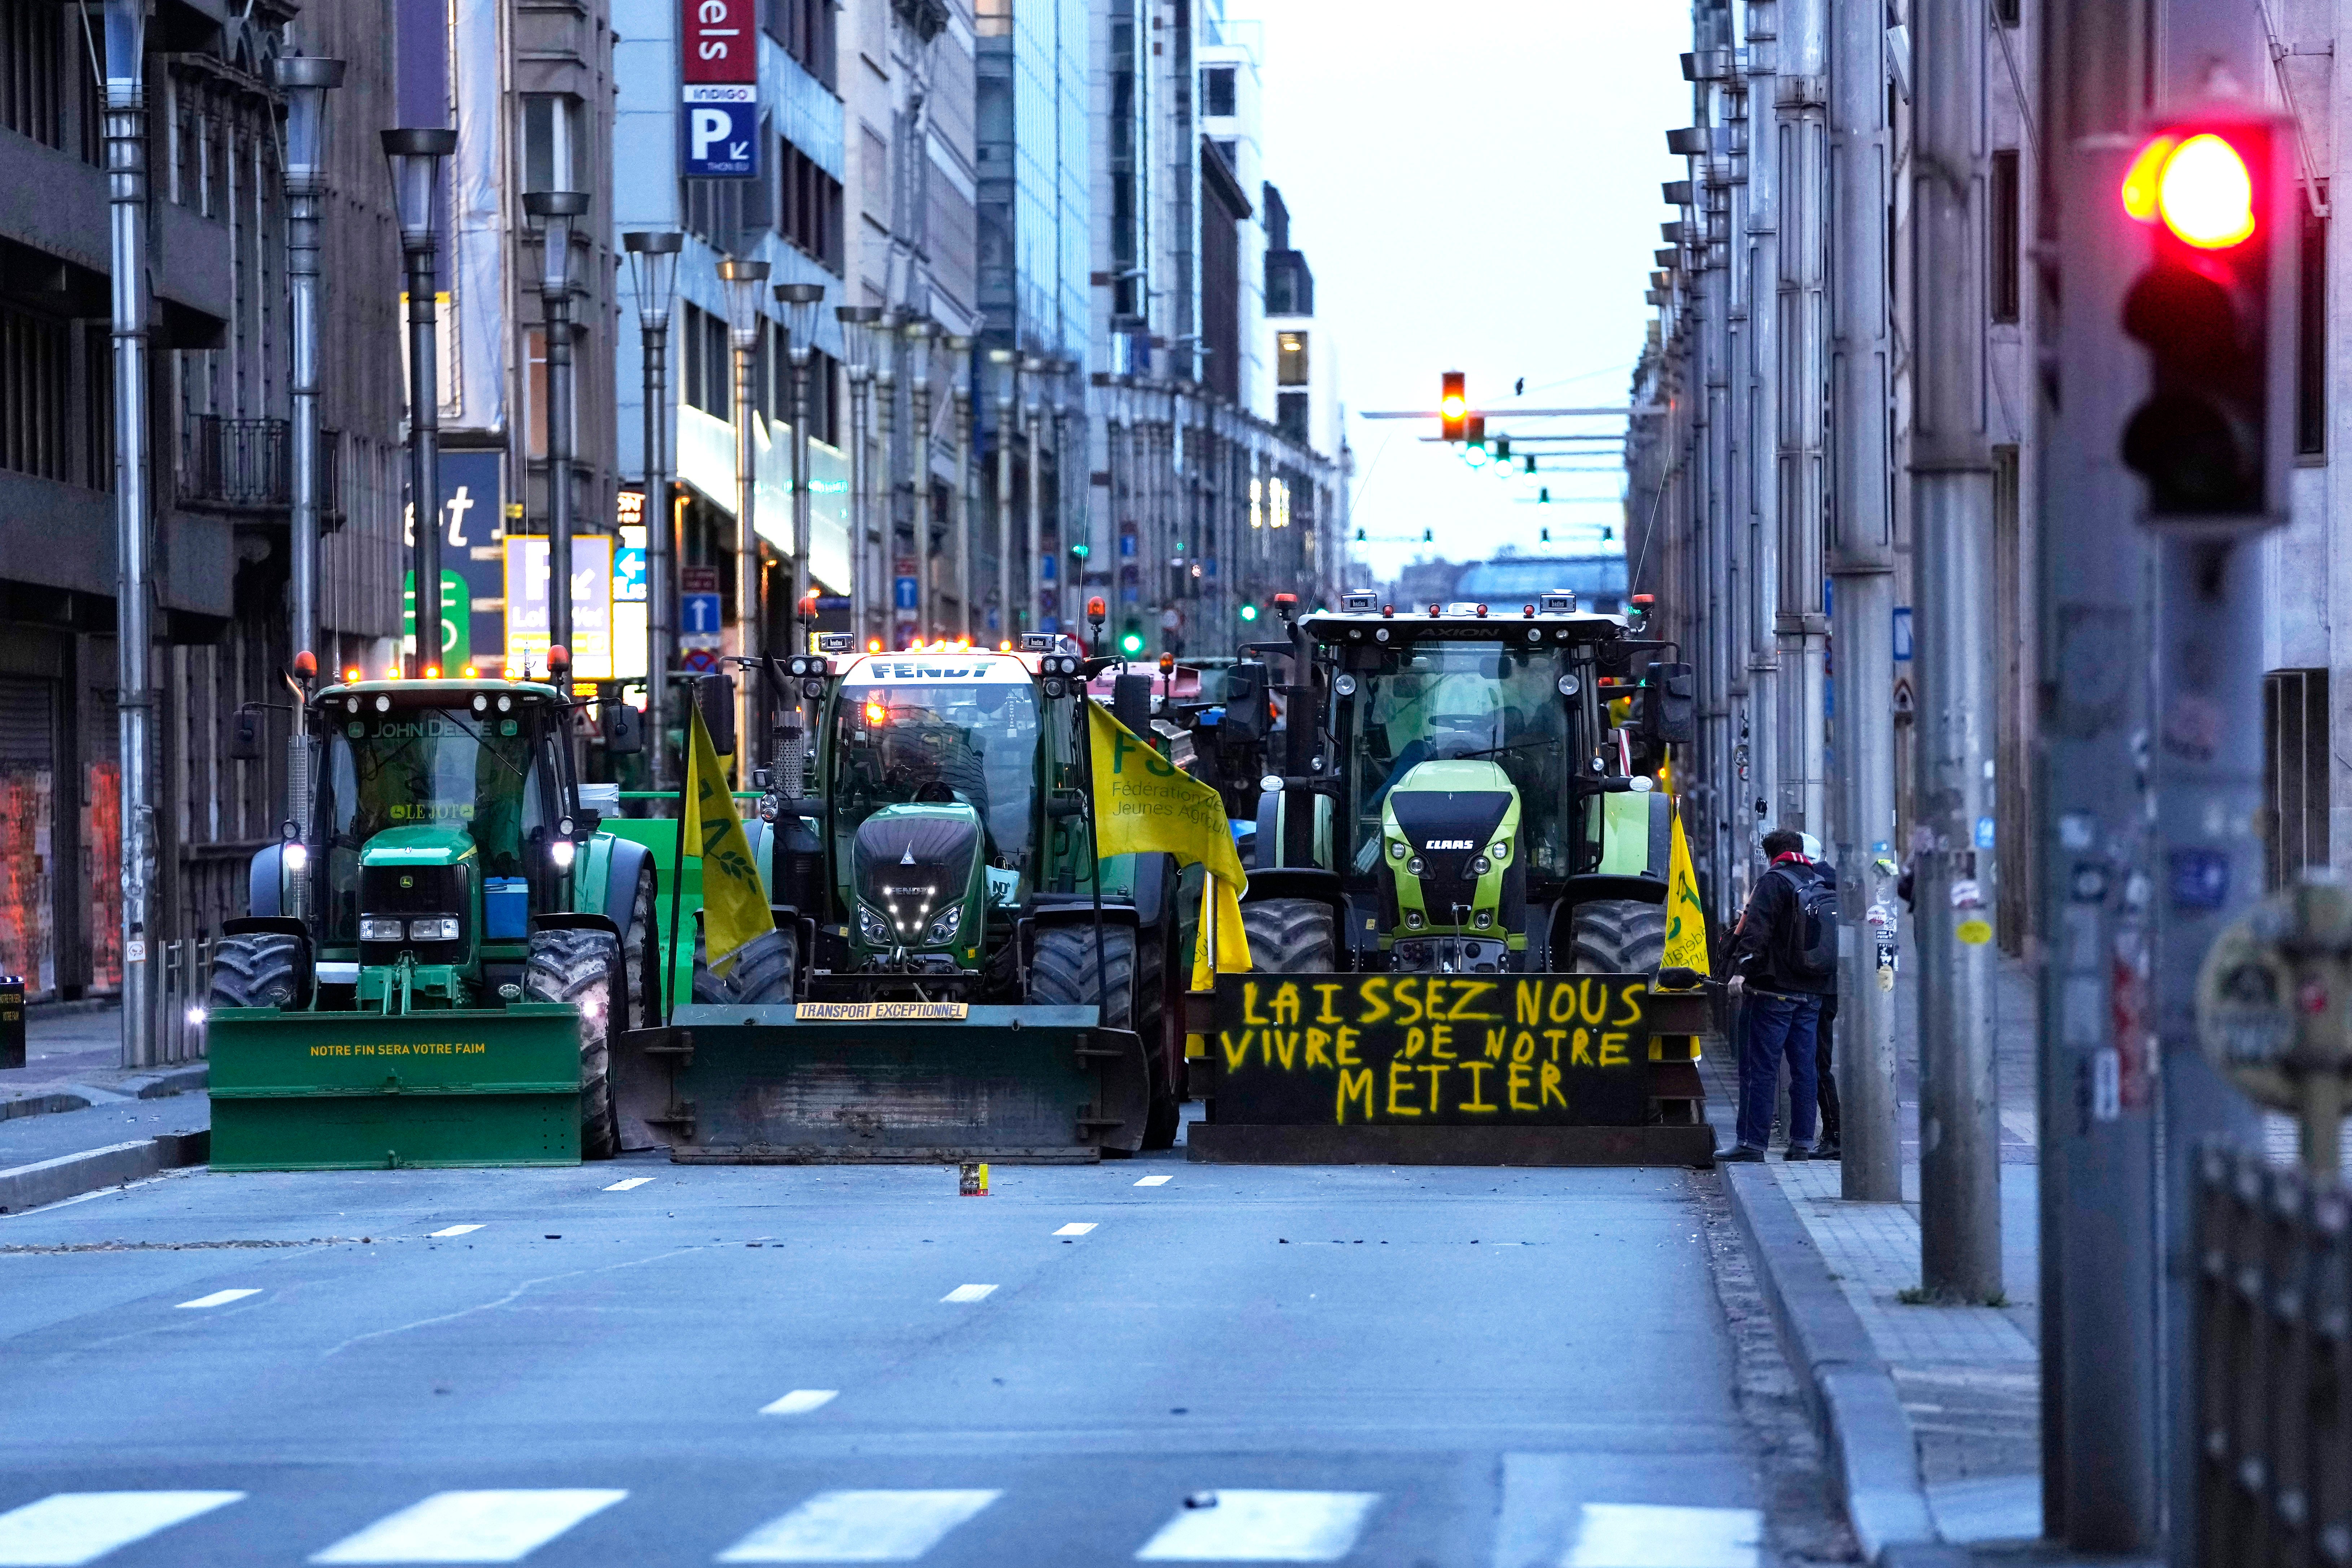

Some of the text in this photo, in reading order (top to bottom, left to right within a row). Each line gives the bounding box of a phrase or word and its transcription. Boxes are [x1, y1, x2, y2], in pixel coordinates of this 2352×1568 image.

[691, 108, 733, 160] P
[1418, 628, 1500, 636] AXION
[870, 662, 996, 678] FENDT
[371, 720, 492, 738] JOHN DEERE
[1112, 781, 1200, 804] Fédération
[1112, 801, 1173, 816] Jeunes
[1425, 840, 1473, 849] CLAAS
[1516, 977, 1646, 1026] NOUS
[801, 1004, 963, 1017] TRANSPORT EXCEPTIONNEL
[310, 1043, 485, 1056] NOTRE FIN SERA VOTRE FAIM
[1220, 1023, 1630, 1074] VIVRE DE NOTRE
[1336, 1050, 1568, 1125] MÉTIER
